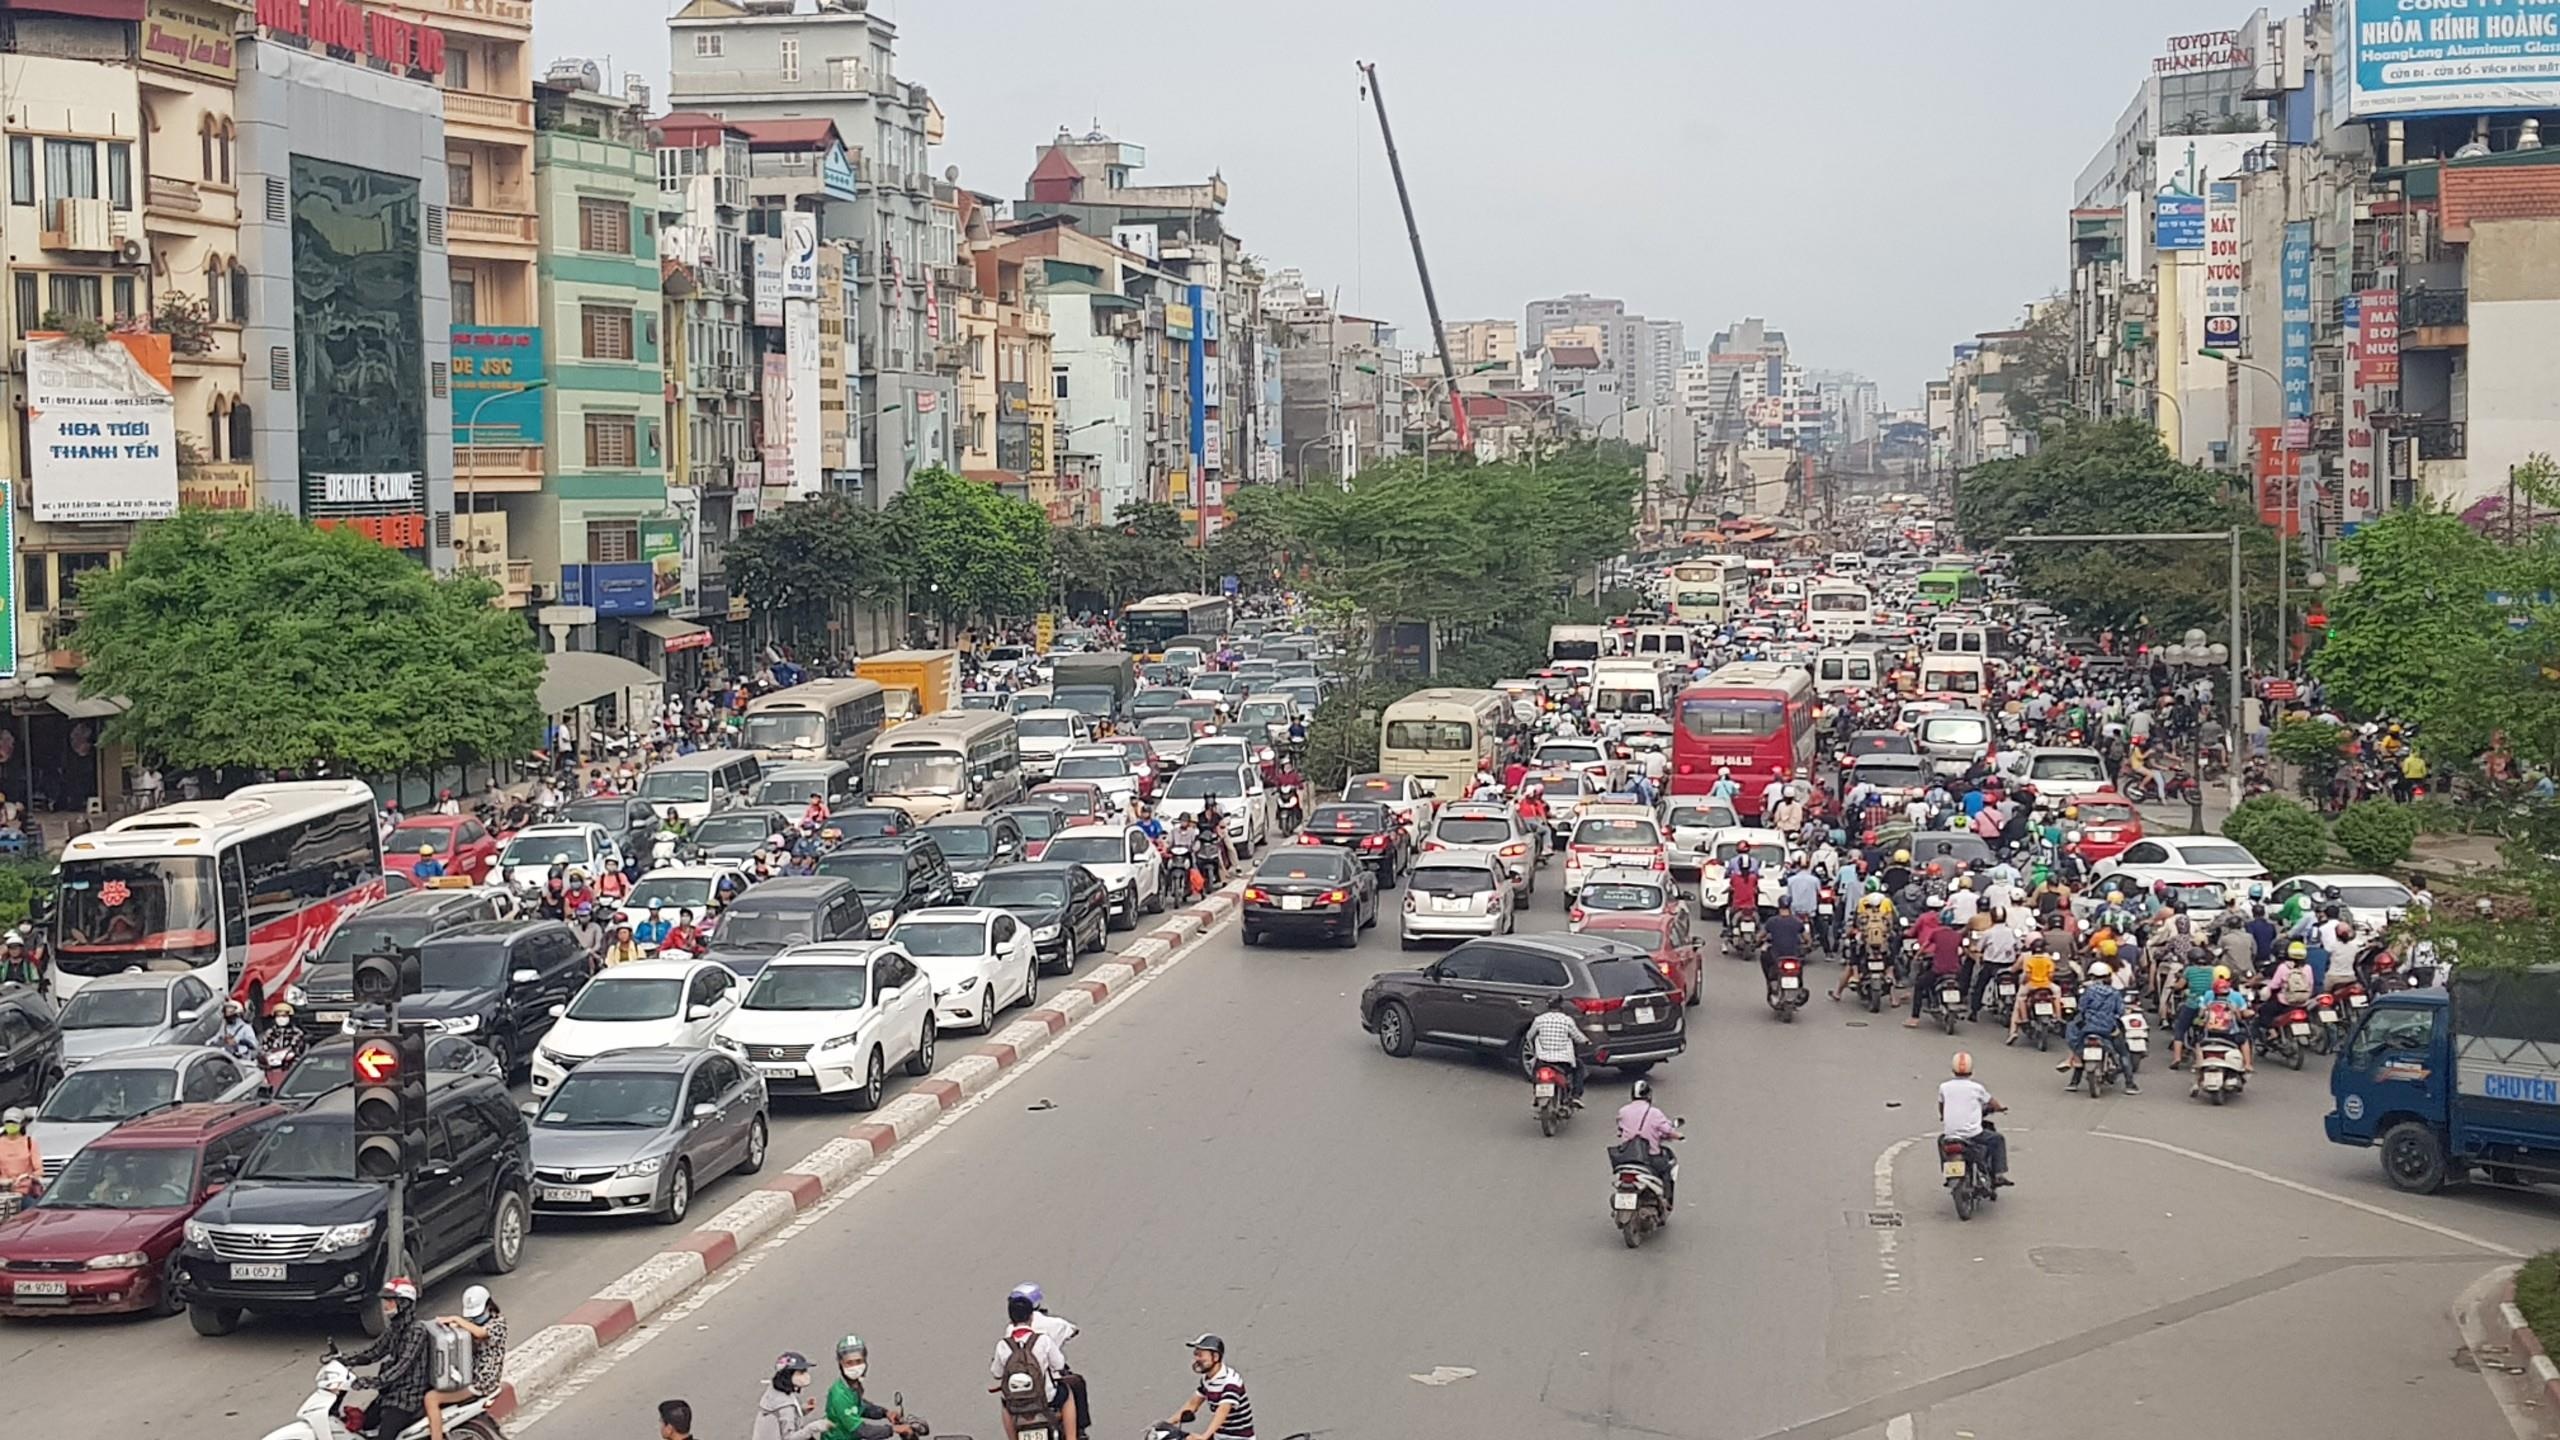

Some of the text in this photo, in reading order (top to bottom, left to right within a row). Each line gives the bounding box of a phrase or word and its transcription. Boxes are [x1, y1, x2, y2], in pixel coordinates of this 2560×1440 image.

[2362, 10, 2558, 45] NHÔM KÍNH HOÀNG
[2168, 32, 2231, 50] TOYOTA
[2362, 47, 2443, 63] HoangLong
[2447, 43, 2521, 57] Aluminum
[2211, 213, 2235, 233] MÁY
[2211, 240, 2237, 256] BƠM
[791, 265, 811, 280] 630
[2207, 259, 2240, 280] NƯỚC
[480, 357, 513, 375] JSC
[58, 421, 150, 436] HOA TƯƠI
[2348, 429, 2371, 448] Sinh
[50, 440, 159, 459] THANH YẾN
[2350, 459, 2369, 478] Cao
[325, 472, 413, 502] DENTAL CLINIC
[2350, 486, 2369, 508] Cấp
